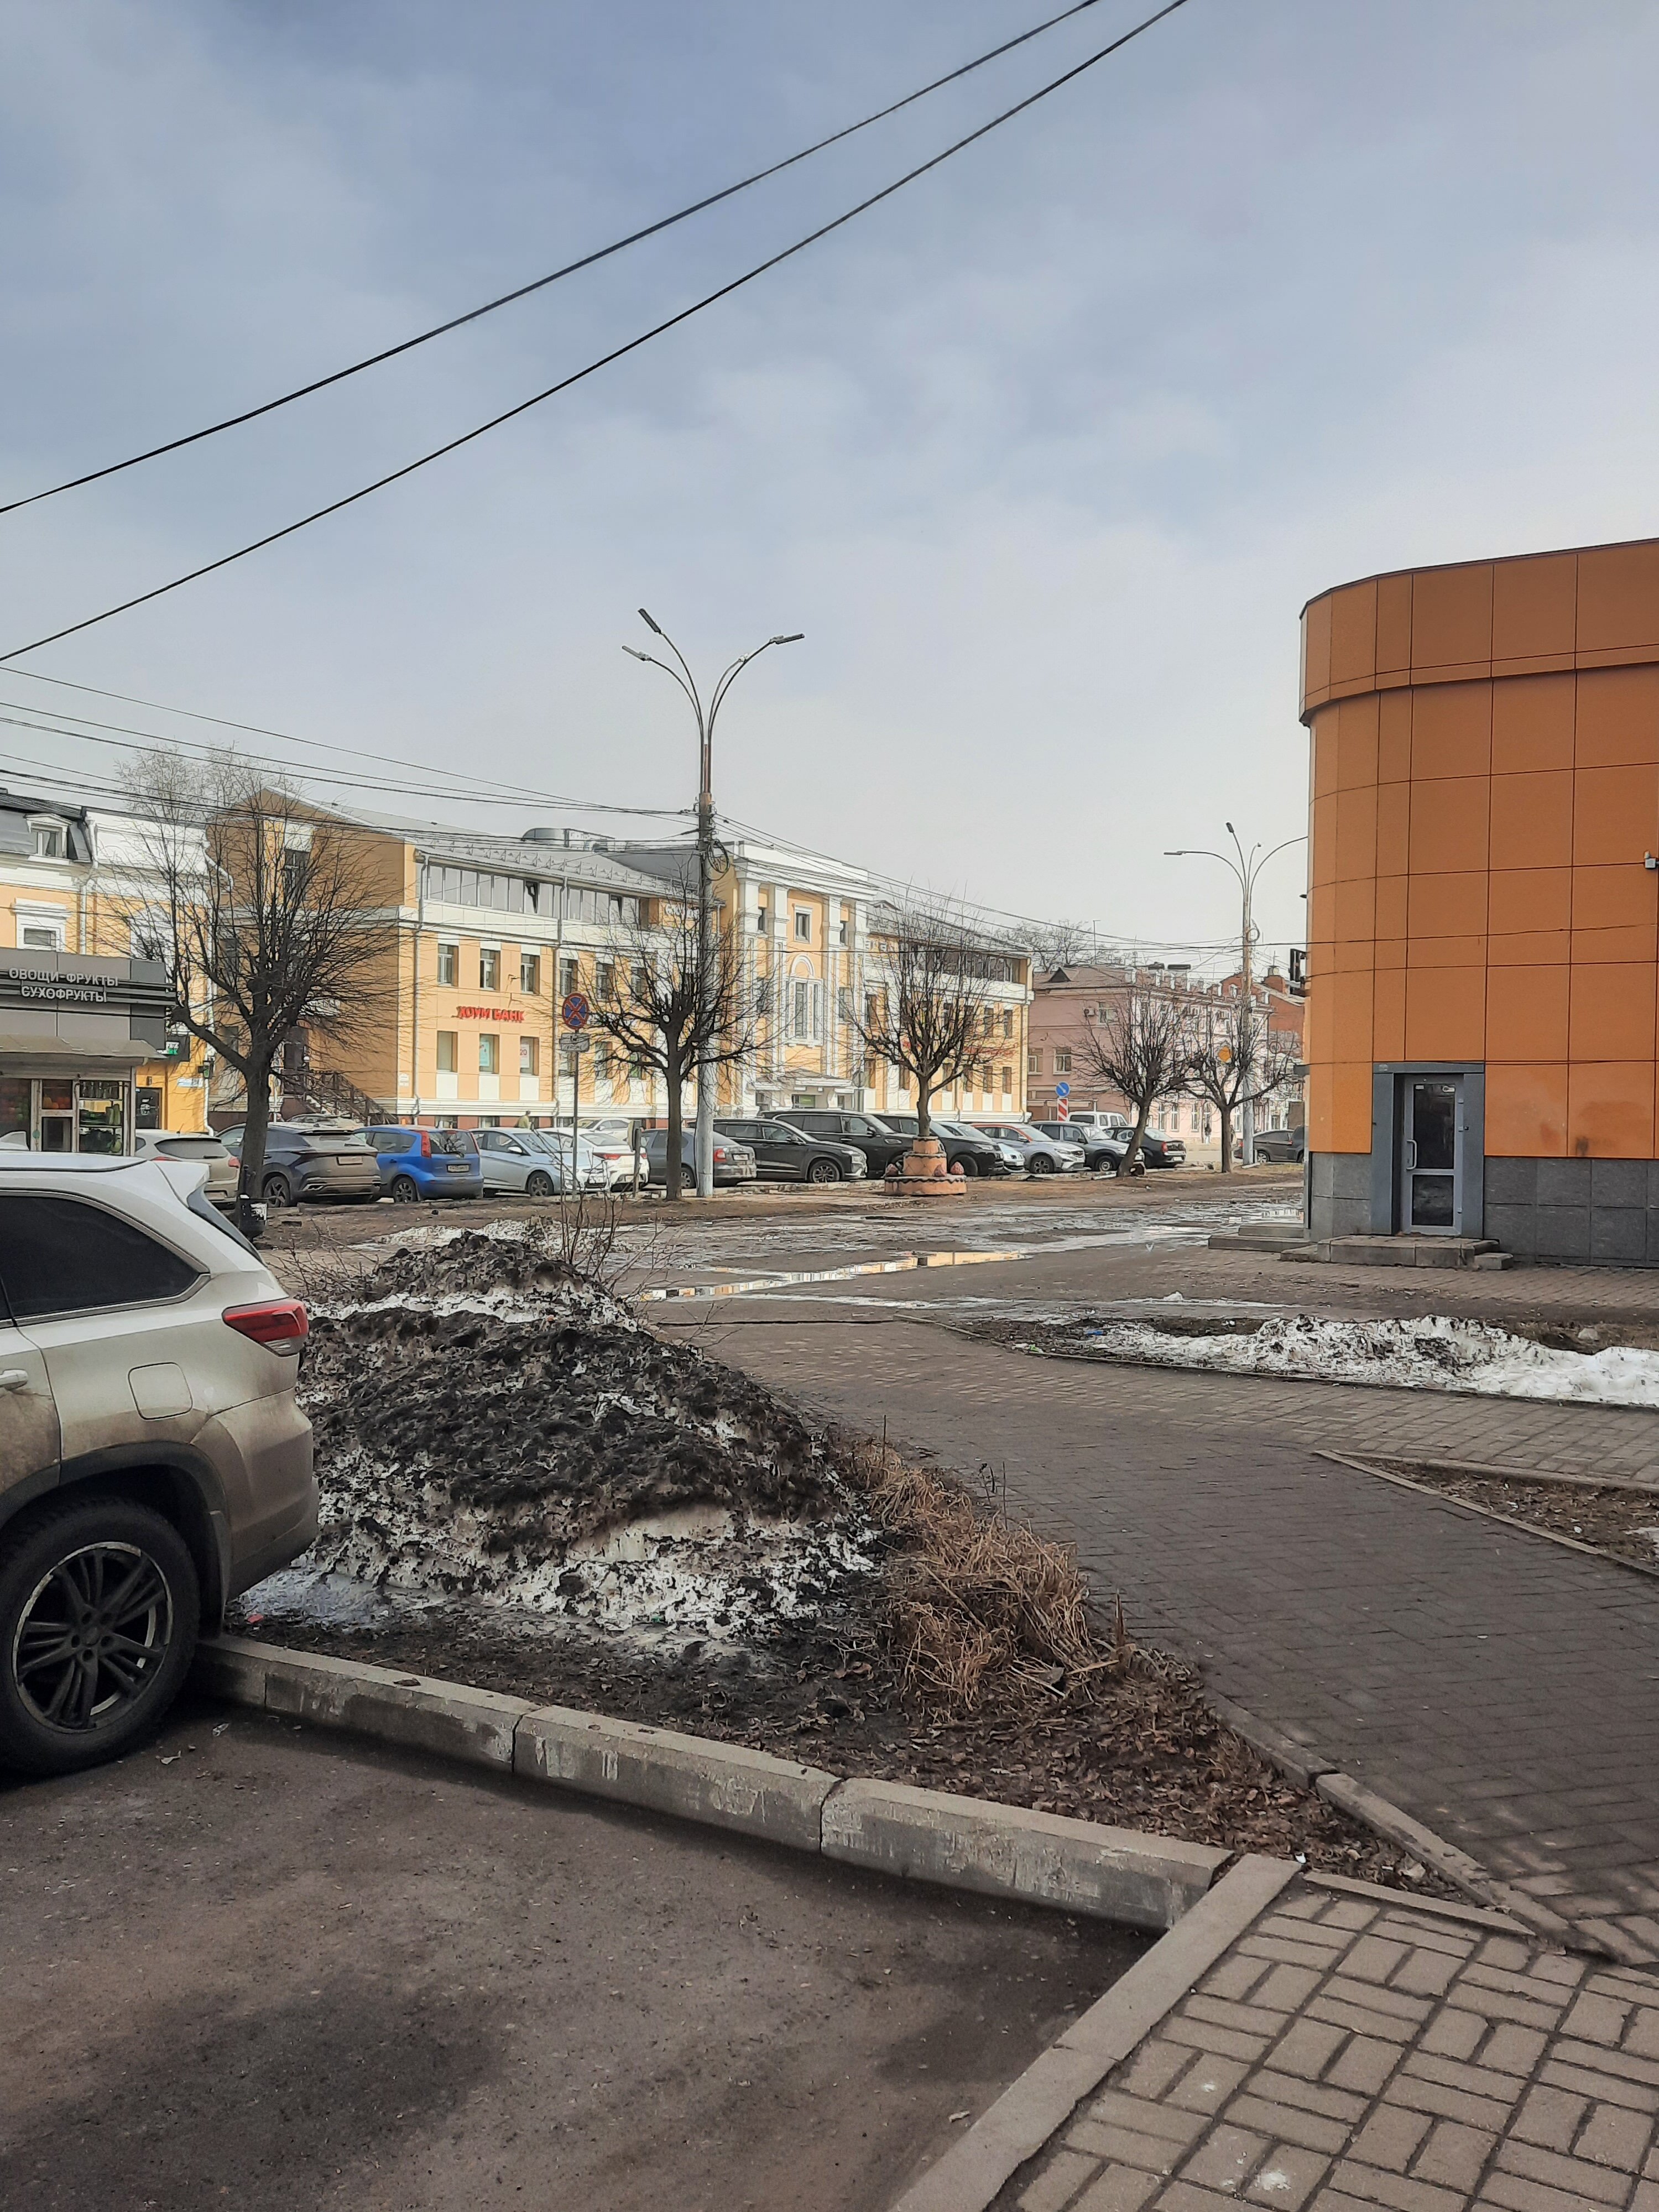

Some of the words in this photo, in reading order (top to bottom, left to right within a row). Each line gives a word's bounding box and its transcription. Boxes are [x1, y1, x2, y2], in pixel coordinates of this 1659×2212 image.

[9, 968, 118, 986] ОВОЩИ-ФРУКТЫ
[21, 985, 107, 1003] СУХОФРУКТЫ
[493, 1009, 525, 1022] БАНК
